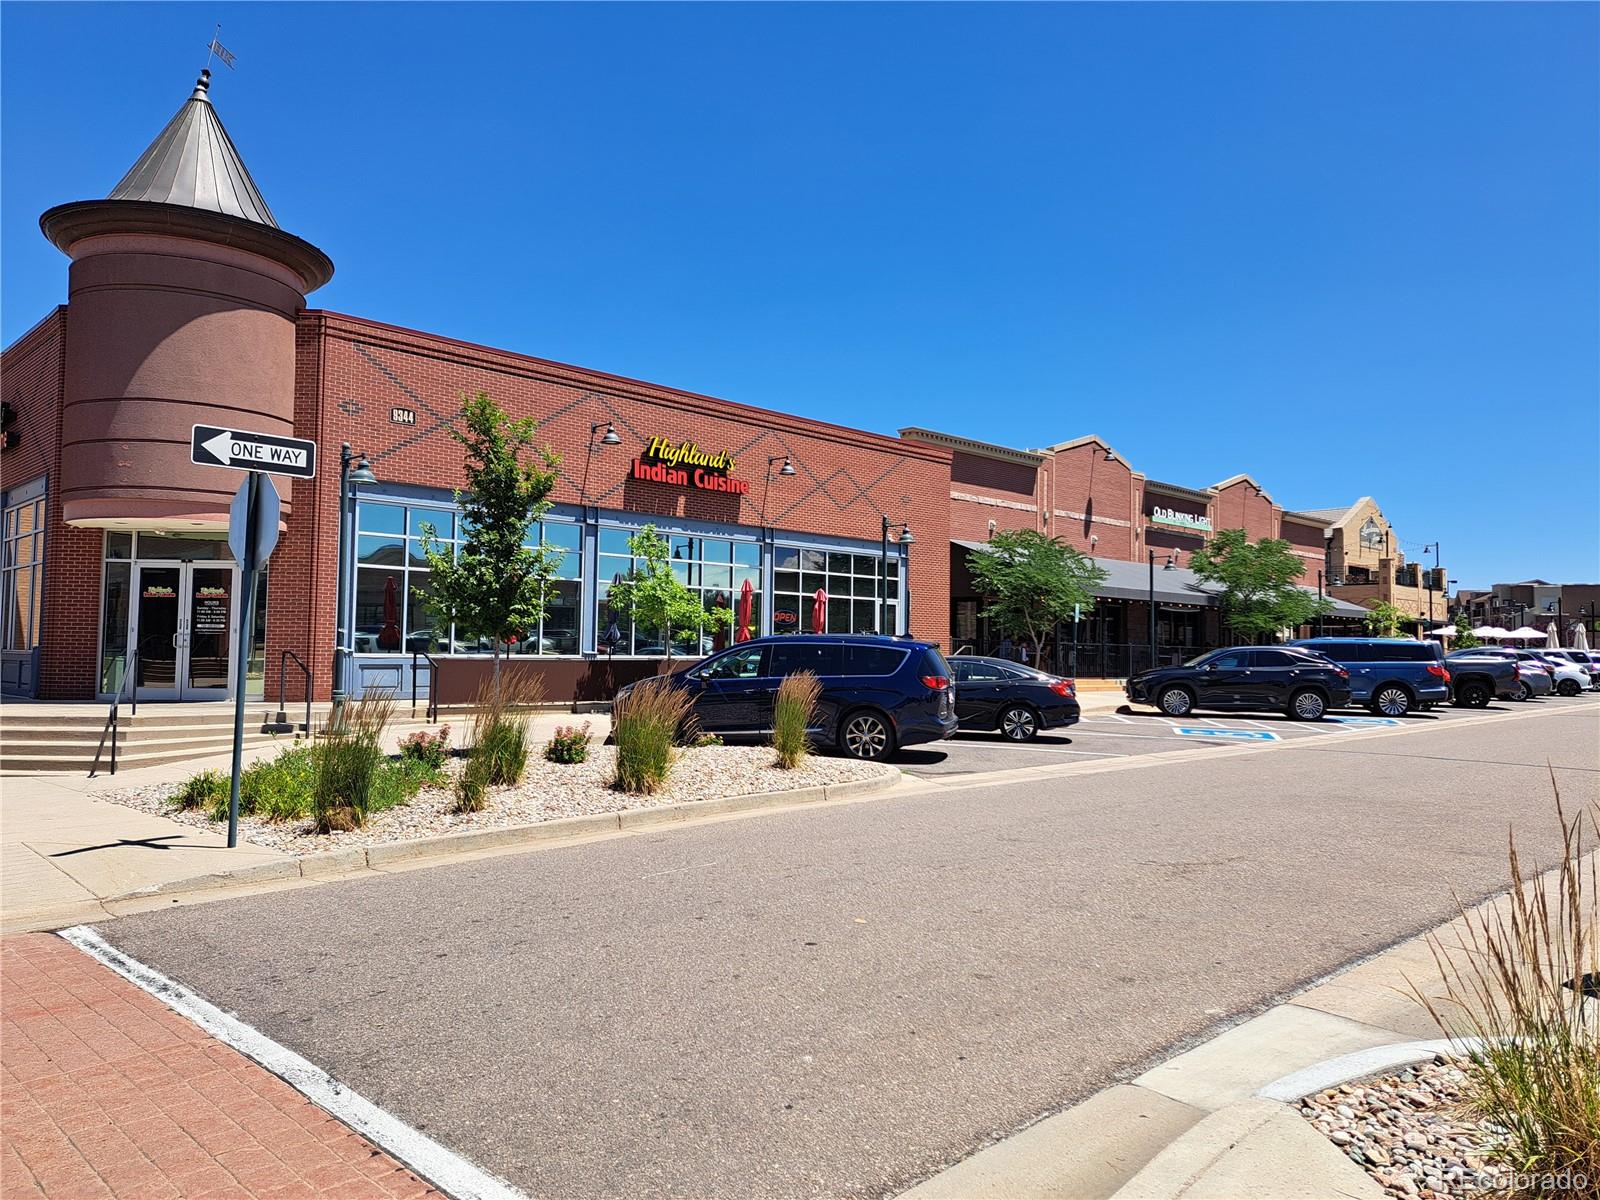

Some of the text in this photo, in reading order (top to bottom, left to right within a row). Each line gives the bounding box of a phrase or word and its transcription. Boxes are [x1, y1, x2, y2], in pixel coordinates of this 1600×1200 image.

[392, 409, 414, 423] 9344
[231, 442, 302, 465] ONE WAY
[648, 435, 737, 471] Highland's
[633, 458, 750, 494] Indian Cuisine
[774, 612, 797, 622] OPEN
